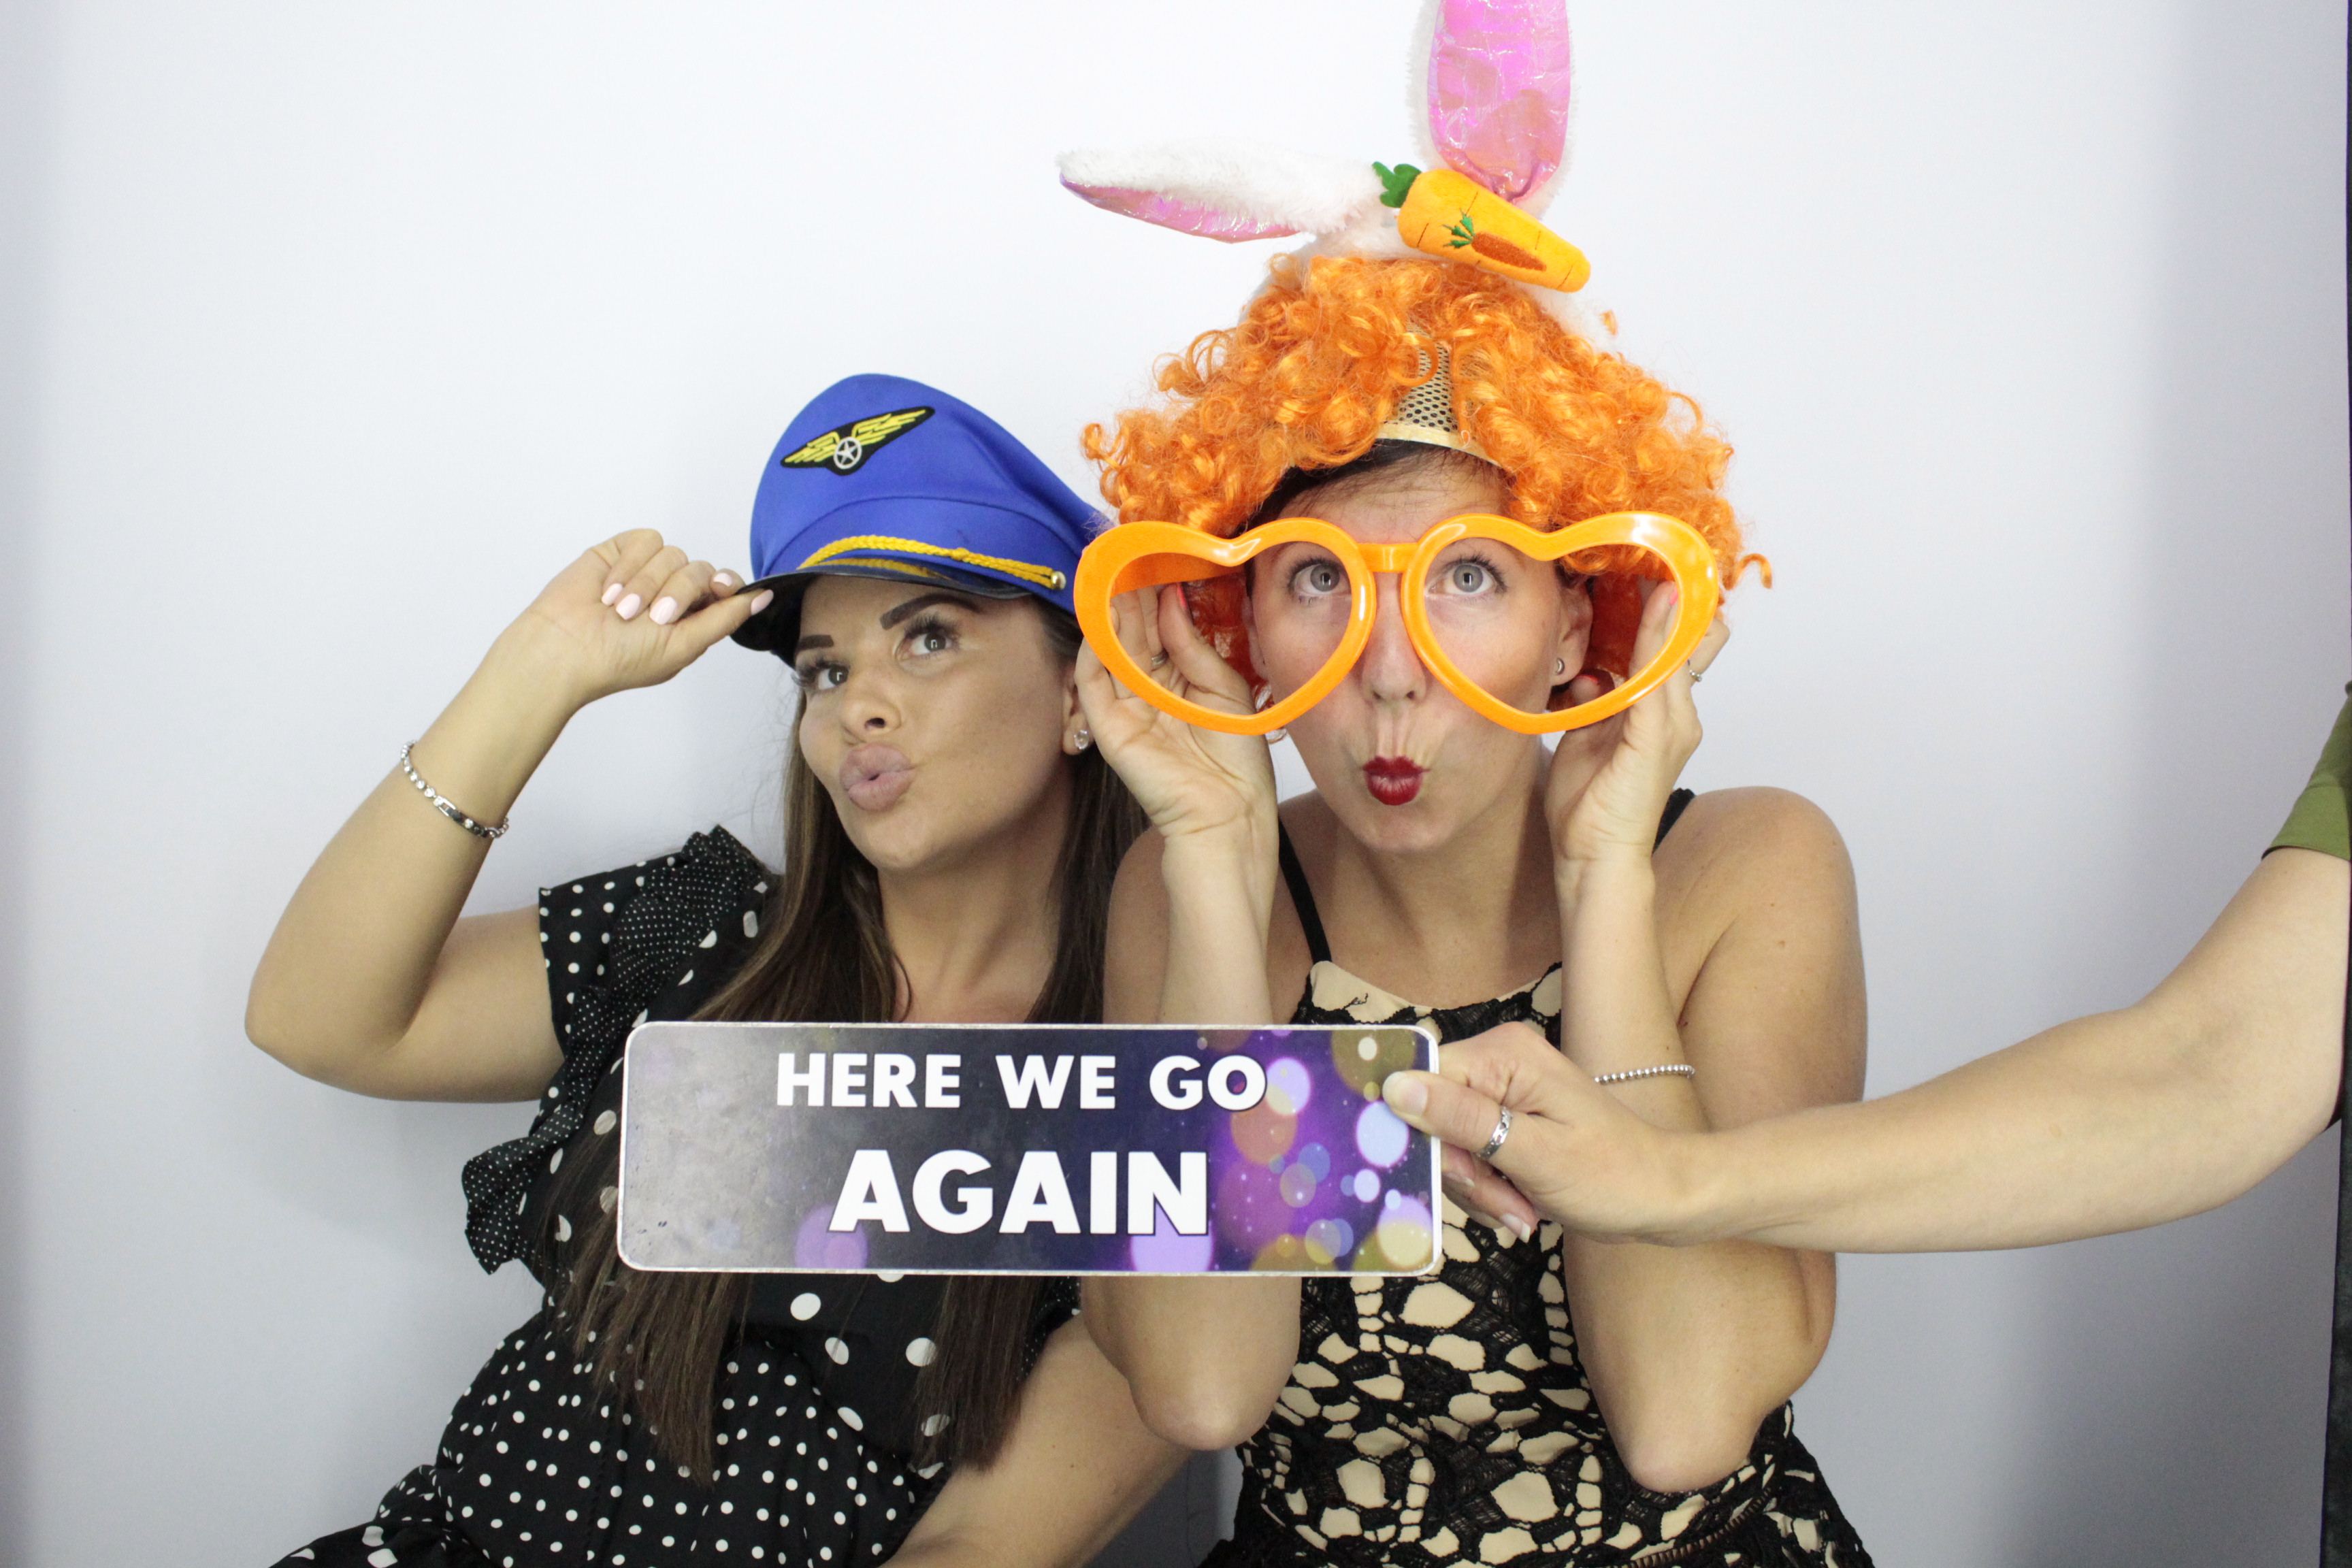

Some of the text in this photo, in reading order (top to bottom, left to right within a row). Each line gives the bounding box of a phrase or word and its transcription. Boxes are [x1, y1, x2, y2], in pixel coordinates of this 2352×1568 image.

[776, 1052, 1267, 1111] HERE WE GO
[828, 1149, 1209, 1236] AGAIN
